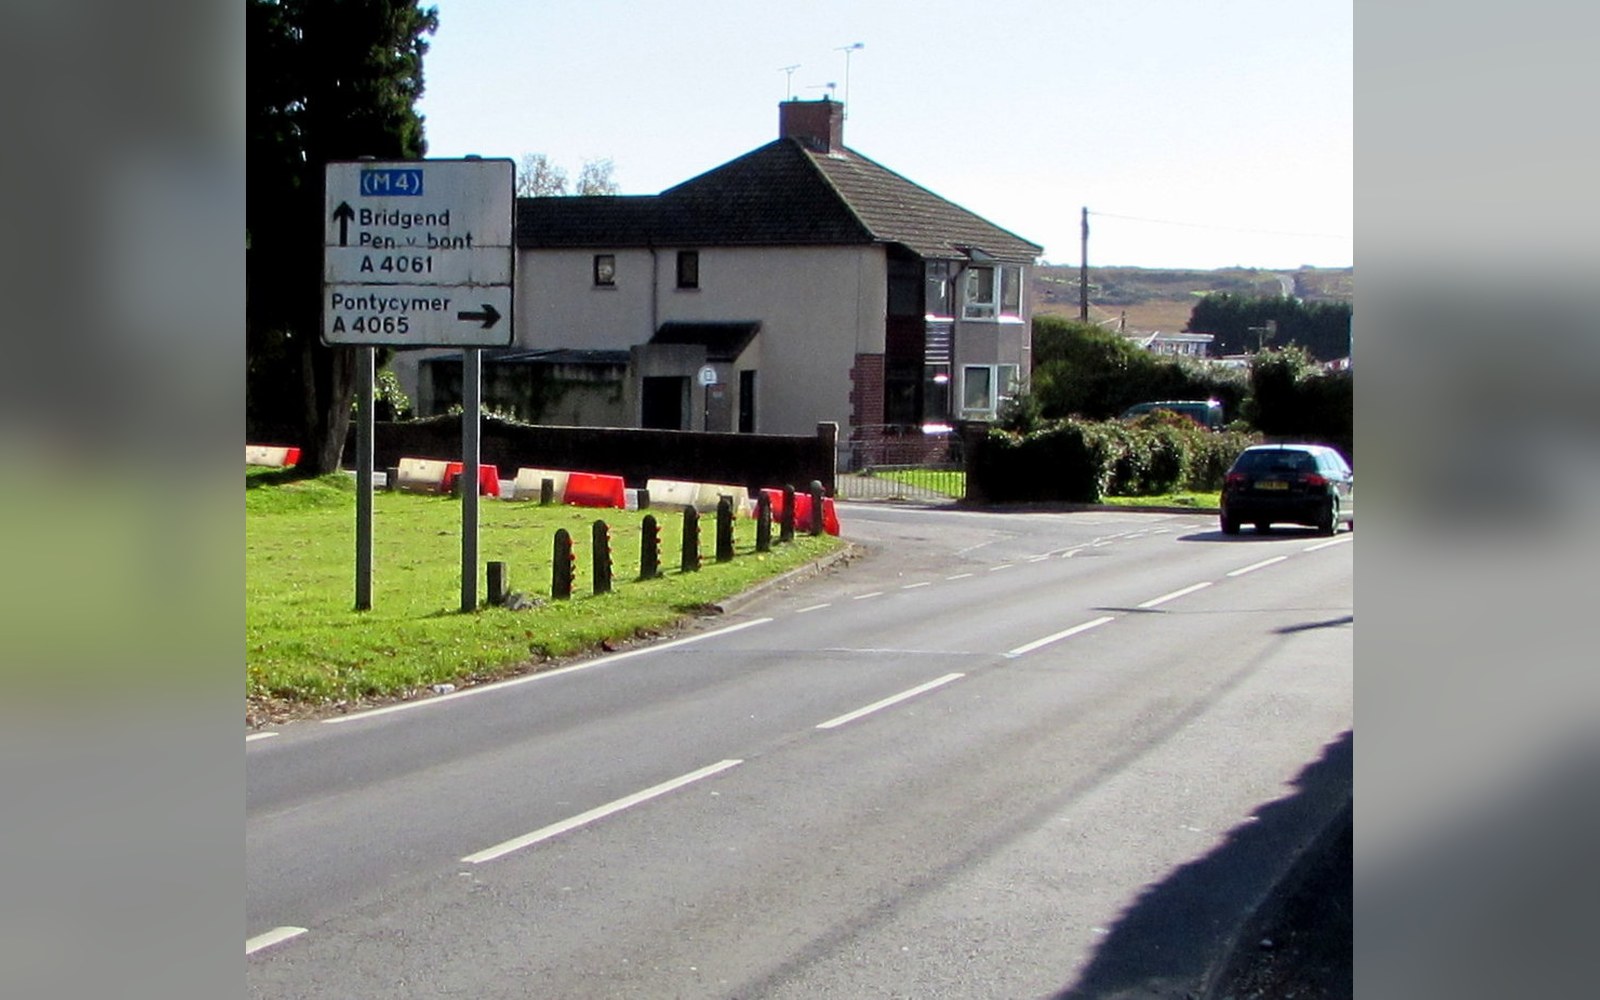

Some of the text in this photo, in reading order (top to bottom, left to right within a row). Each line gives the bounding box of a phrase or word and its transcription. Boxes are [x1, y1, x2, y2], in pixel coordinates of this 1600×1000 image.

[359, 208, 450, 229] Bridgend
[359, 232, 395, 249] Pen
[427, 231, 474, 250] bont
[331, 293, 451, 314] Pontycymer
